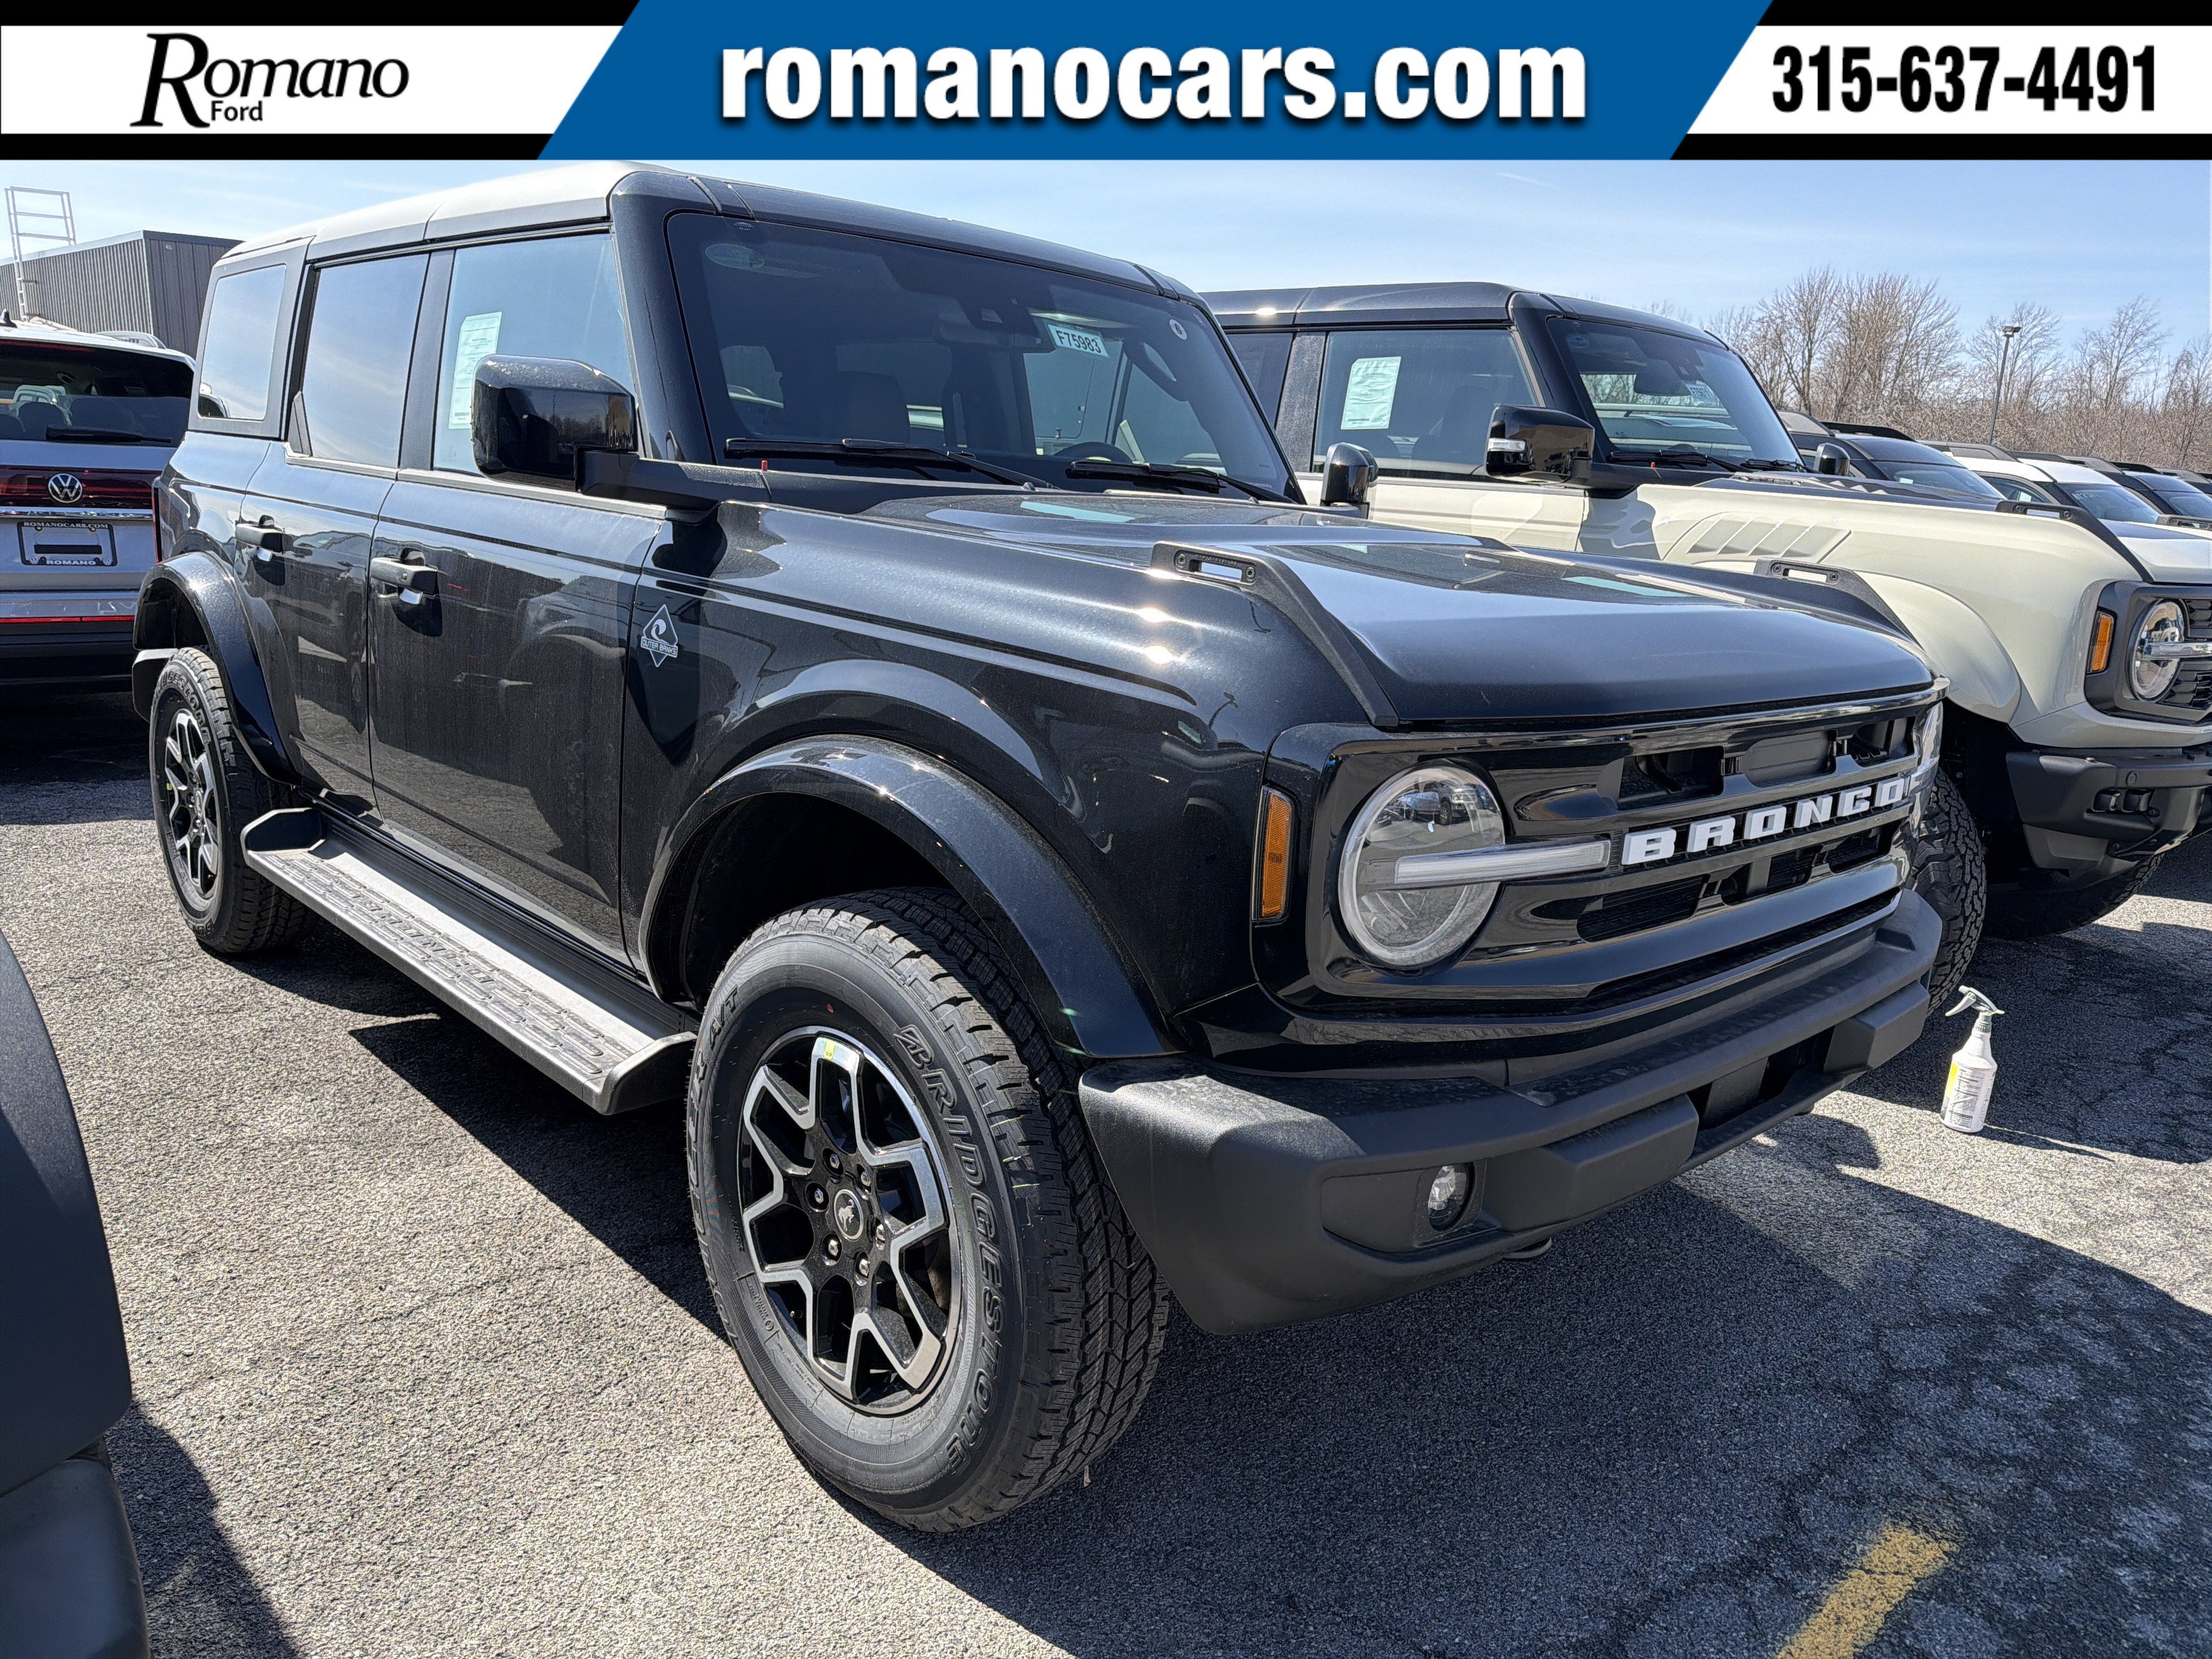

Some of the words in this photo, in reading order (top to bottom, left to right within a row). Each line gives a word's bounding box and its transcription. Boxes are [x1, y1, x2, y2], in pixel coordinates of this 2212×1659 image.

[1055, 329, 1102, 354] F75983
[642, 639, 659, 650] OUTER
[659, 644, 677, 655] BANKS
[1621, 777, 1905, 865] BRONCO
[893, 1024, 1006, 1478] BRIDGESTONE
